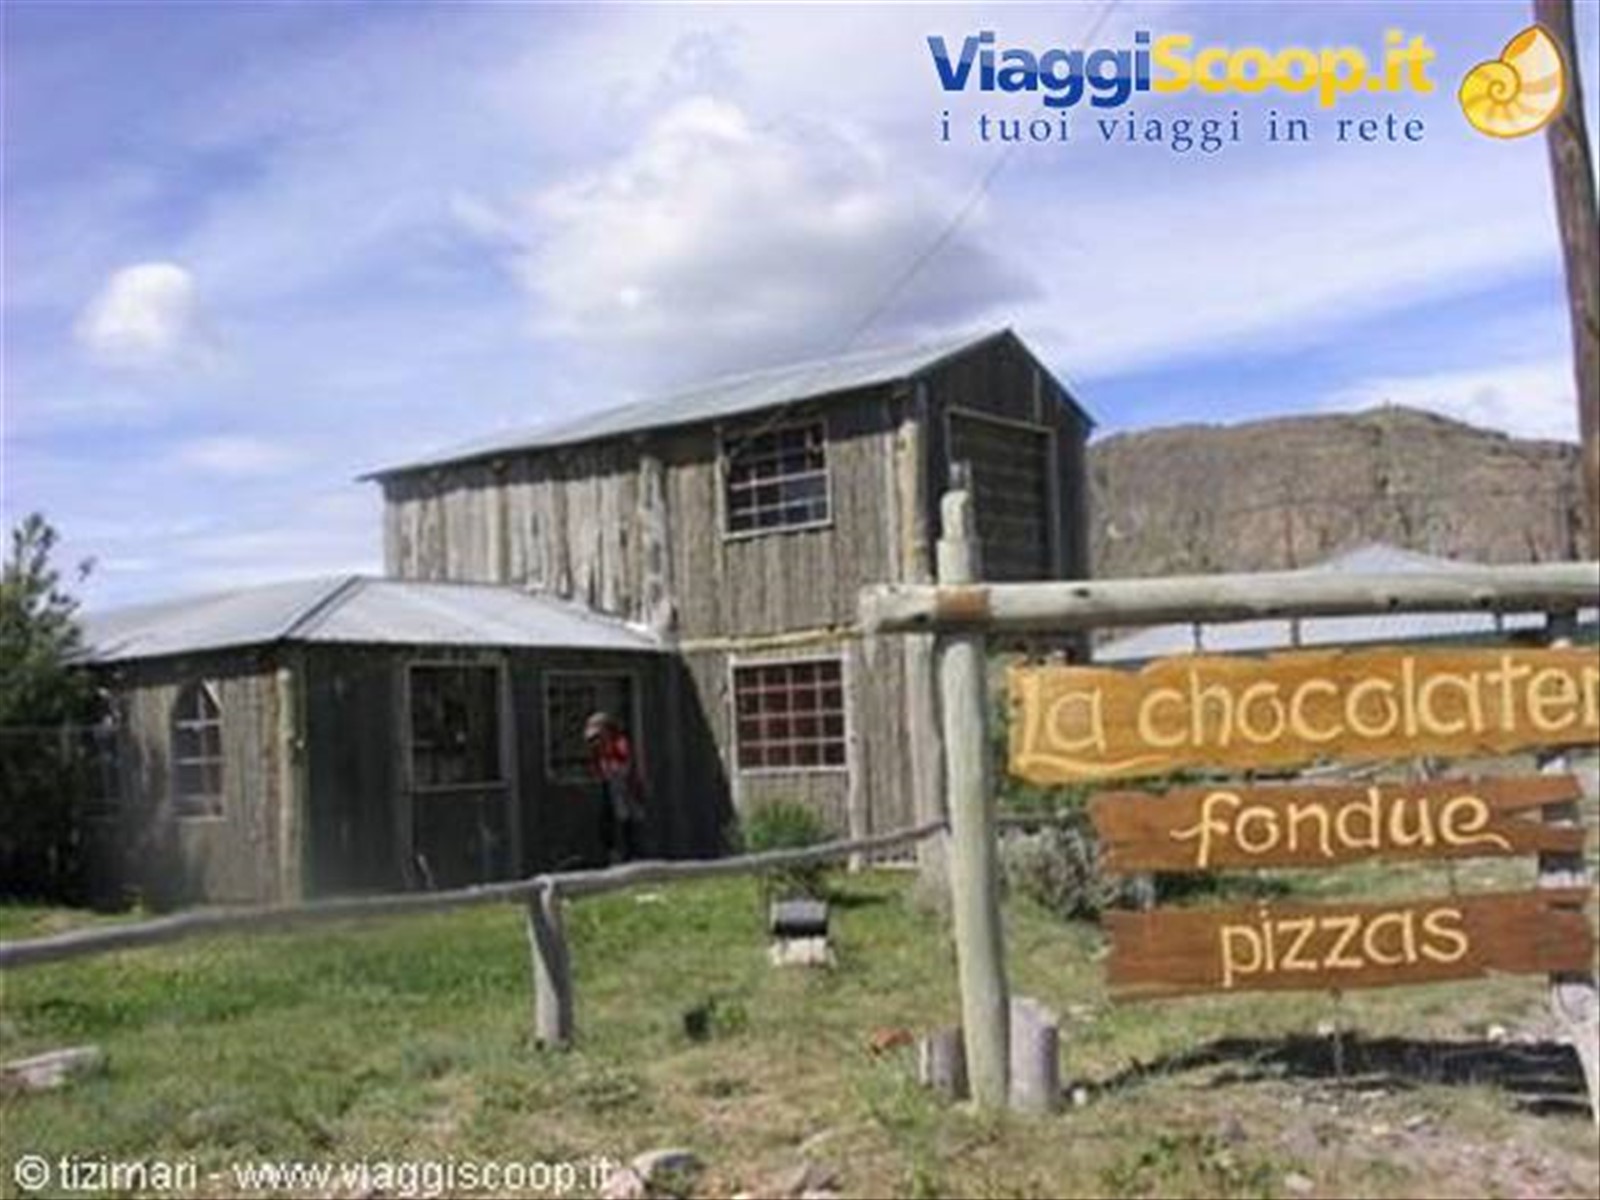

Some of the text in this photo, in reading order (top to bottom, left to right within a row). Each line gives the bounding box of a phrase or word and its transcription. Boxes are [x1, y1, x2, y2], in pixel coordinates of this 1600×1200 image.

[1016, 670, 1122, 768] La
[1170, 787, 1512, 867] fondue
[1219, 906, 1470, 987] pizzas
